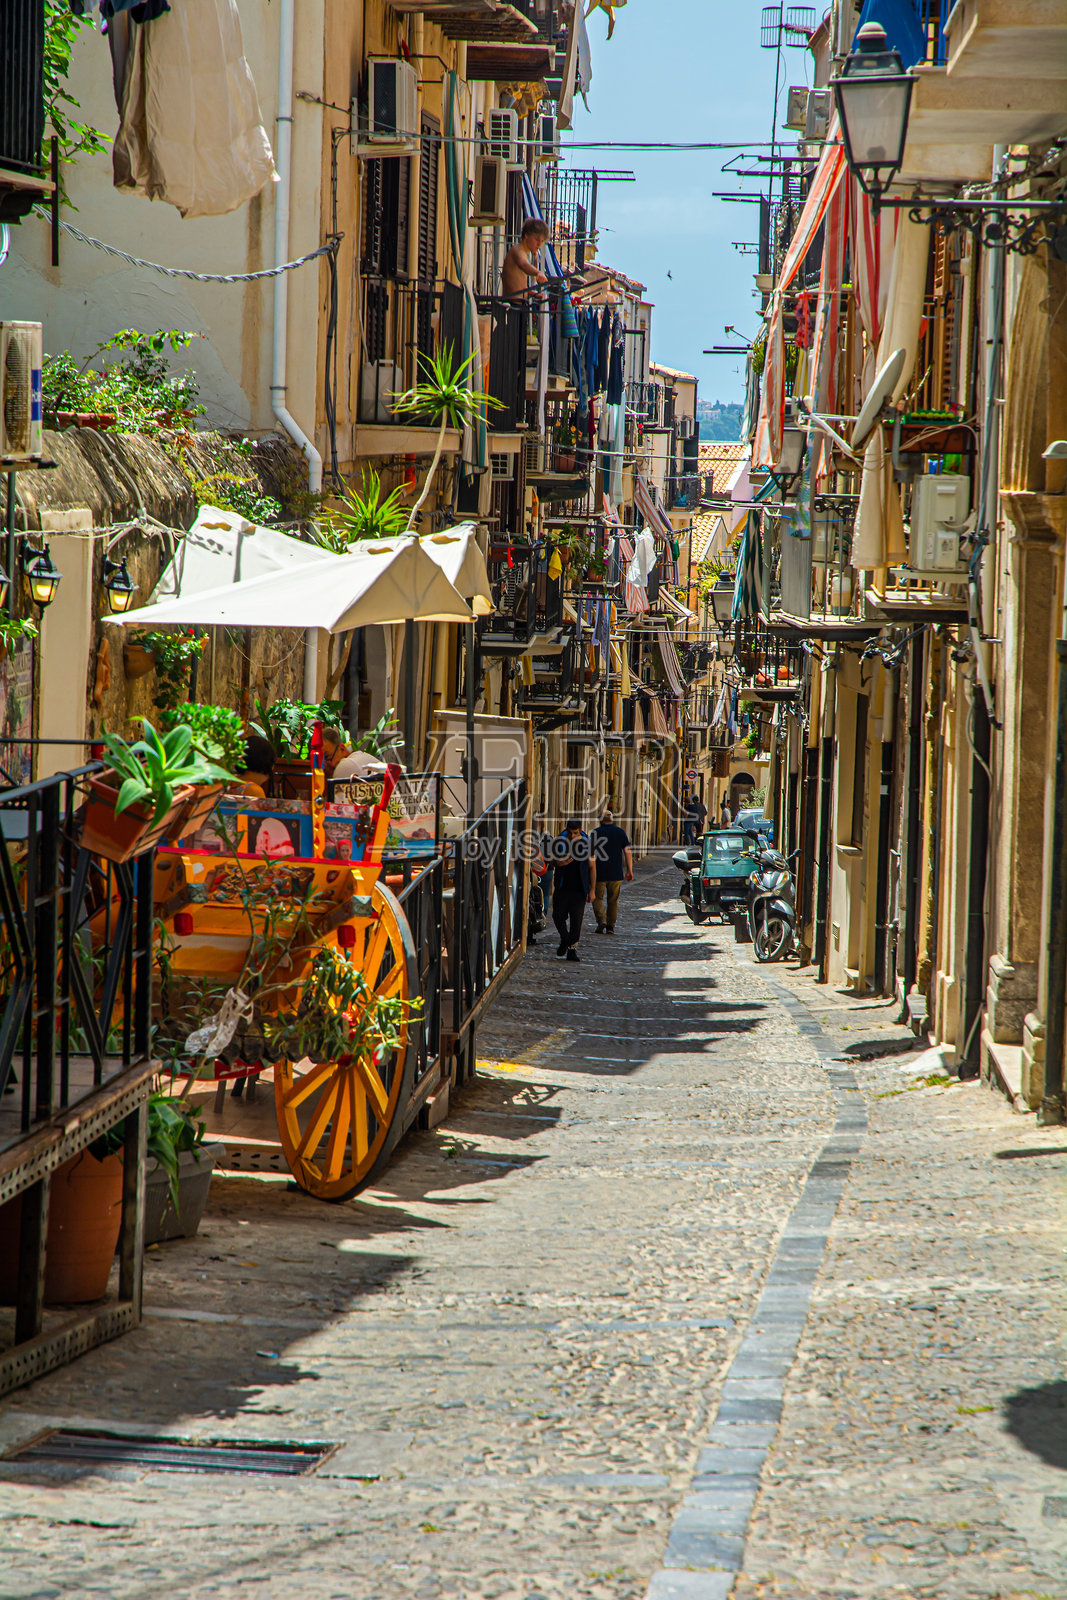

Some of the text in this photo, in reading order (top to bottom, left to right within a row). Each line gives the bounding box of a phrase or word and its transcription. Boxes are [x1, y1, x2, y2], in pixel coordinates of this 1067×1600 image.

[345, 781, 428, 798] RISTOANTE
[389, 794, 428, 805] PIZZERIA
[391, 805, 435, 816] SICILIANA
